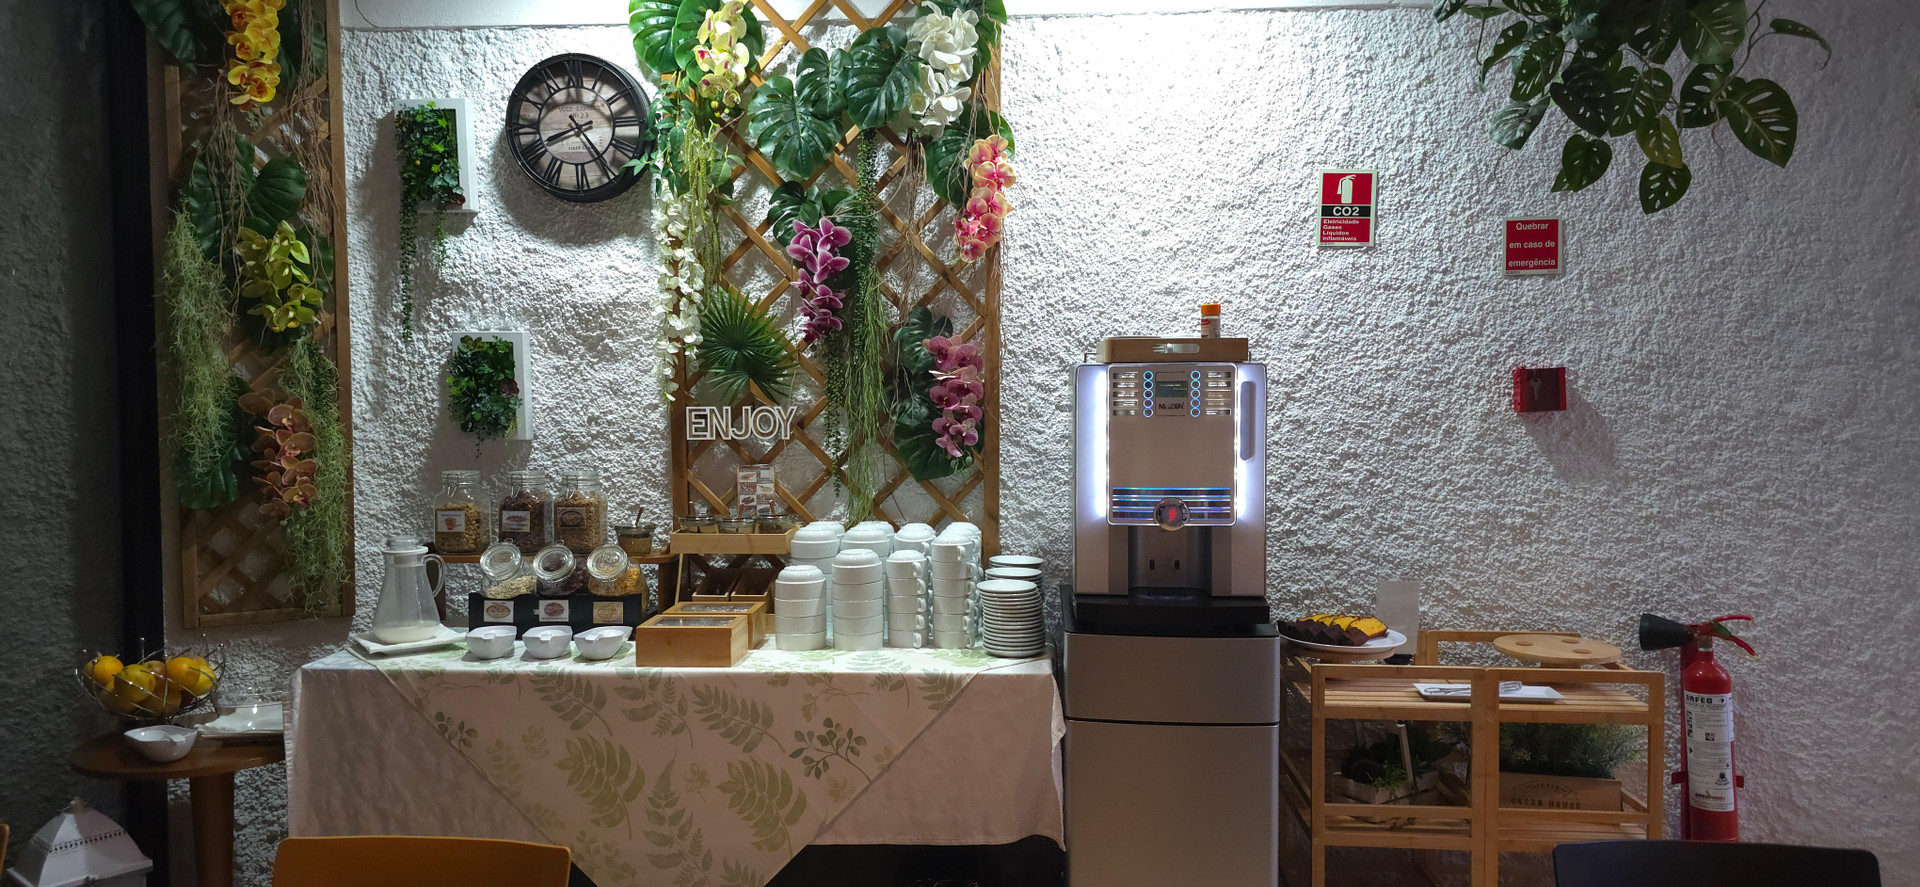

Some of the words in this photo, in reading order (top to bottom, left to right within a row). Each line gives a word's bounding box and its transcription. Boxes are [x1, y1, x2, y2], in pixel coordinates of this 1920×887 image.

[1332, 206, 1360, 216] CO2
[1516, 222, 1549, 230] Quebrar
[1508, 258, 1556, 268] emergência
[686, 406, 798, 440] ENJOY
[1511, 798, 1543, 807] GREEN
[1548, 800, 1582, 810] HOUSE
